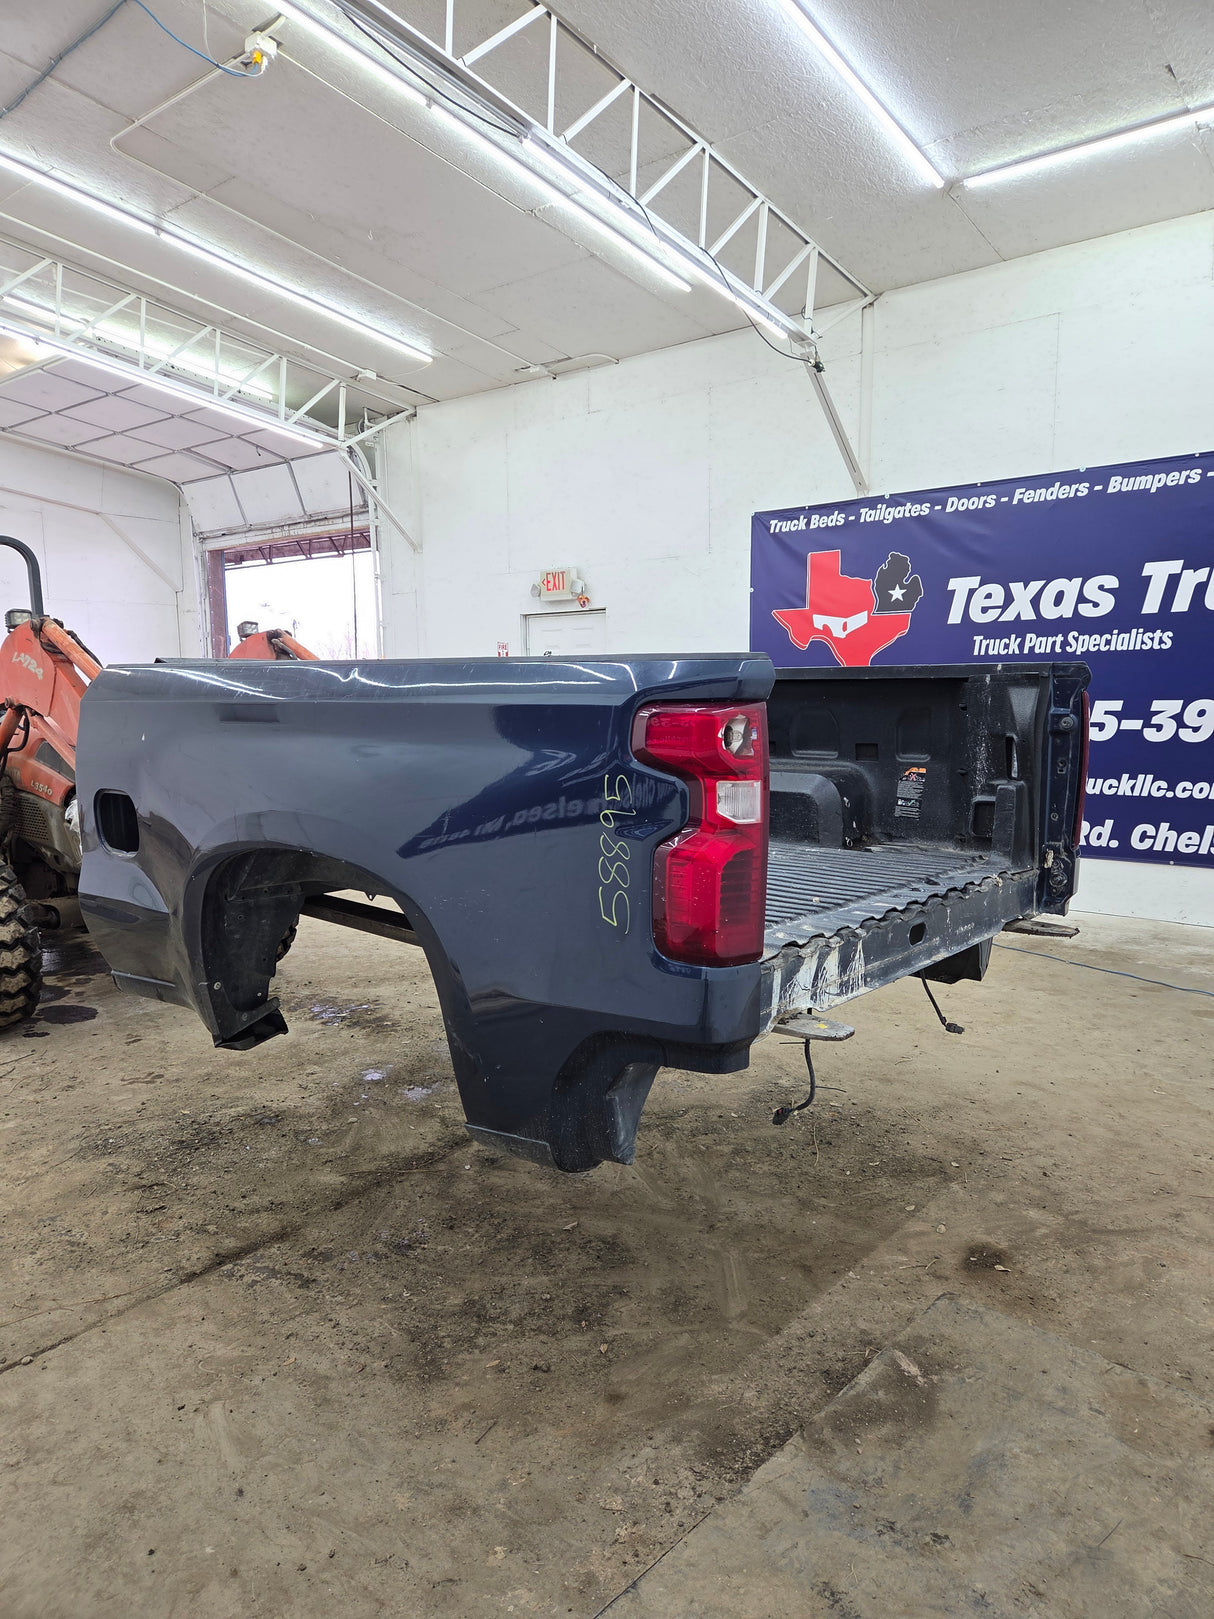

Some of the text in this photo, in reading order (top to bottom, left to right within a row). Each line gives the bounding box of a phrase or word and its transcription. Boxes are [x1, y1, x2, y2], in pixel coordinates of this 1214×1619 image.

[769, 517, 808, 533] Truck
[810, 511, 845, 530] Beds
[859, 502, 930, 524] Tailgates
[945, 494, 996, 513] Doors
[1012, 482, 1089, 505] Fenders
[1106, 468, 1202, 493] Bumpers
[545, 571, 566, 591] EXIT
[946, 574, 1119, 625] Texas
[972, 628, 1173, 656] Truck Part Specialists
[31, 779, 53, 796] L3540
[599, 774, 637, 934] 58895
[1130, 822, 1214, 855] Chel
